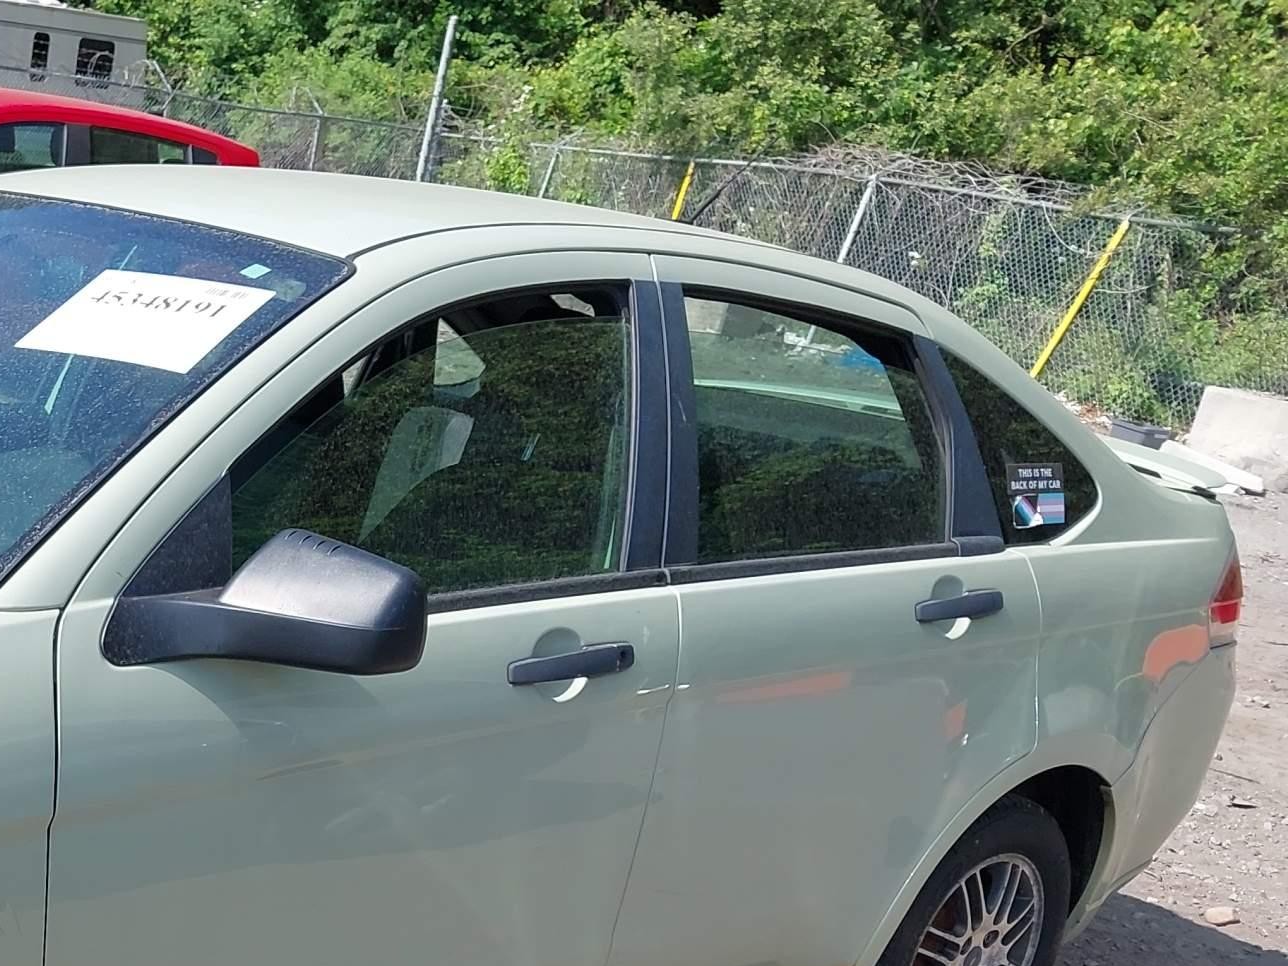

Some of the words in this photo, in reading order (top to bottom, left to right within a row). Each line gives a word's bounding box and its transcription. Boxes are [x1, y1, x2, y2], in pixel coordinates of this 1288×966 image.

[91, 290, 227, 317] 45348191
[1018, 468, 1032, 478] THIS
[1033, 468, 1039, 477] IS
[1040, 468, 1052, 477] THE
[1011, 480, 1027, 490] BACK
[1028, 480, 1037, 489] OF
[1038, 480, 1048, 489] MY
[1049, 479, 1061, 489] CAR
